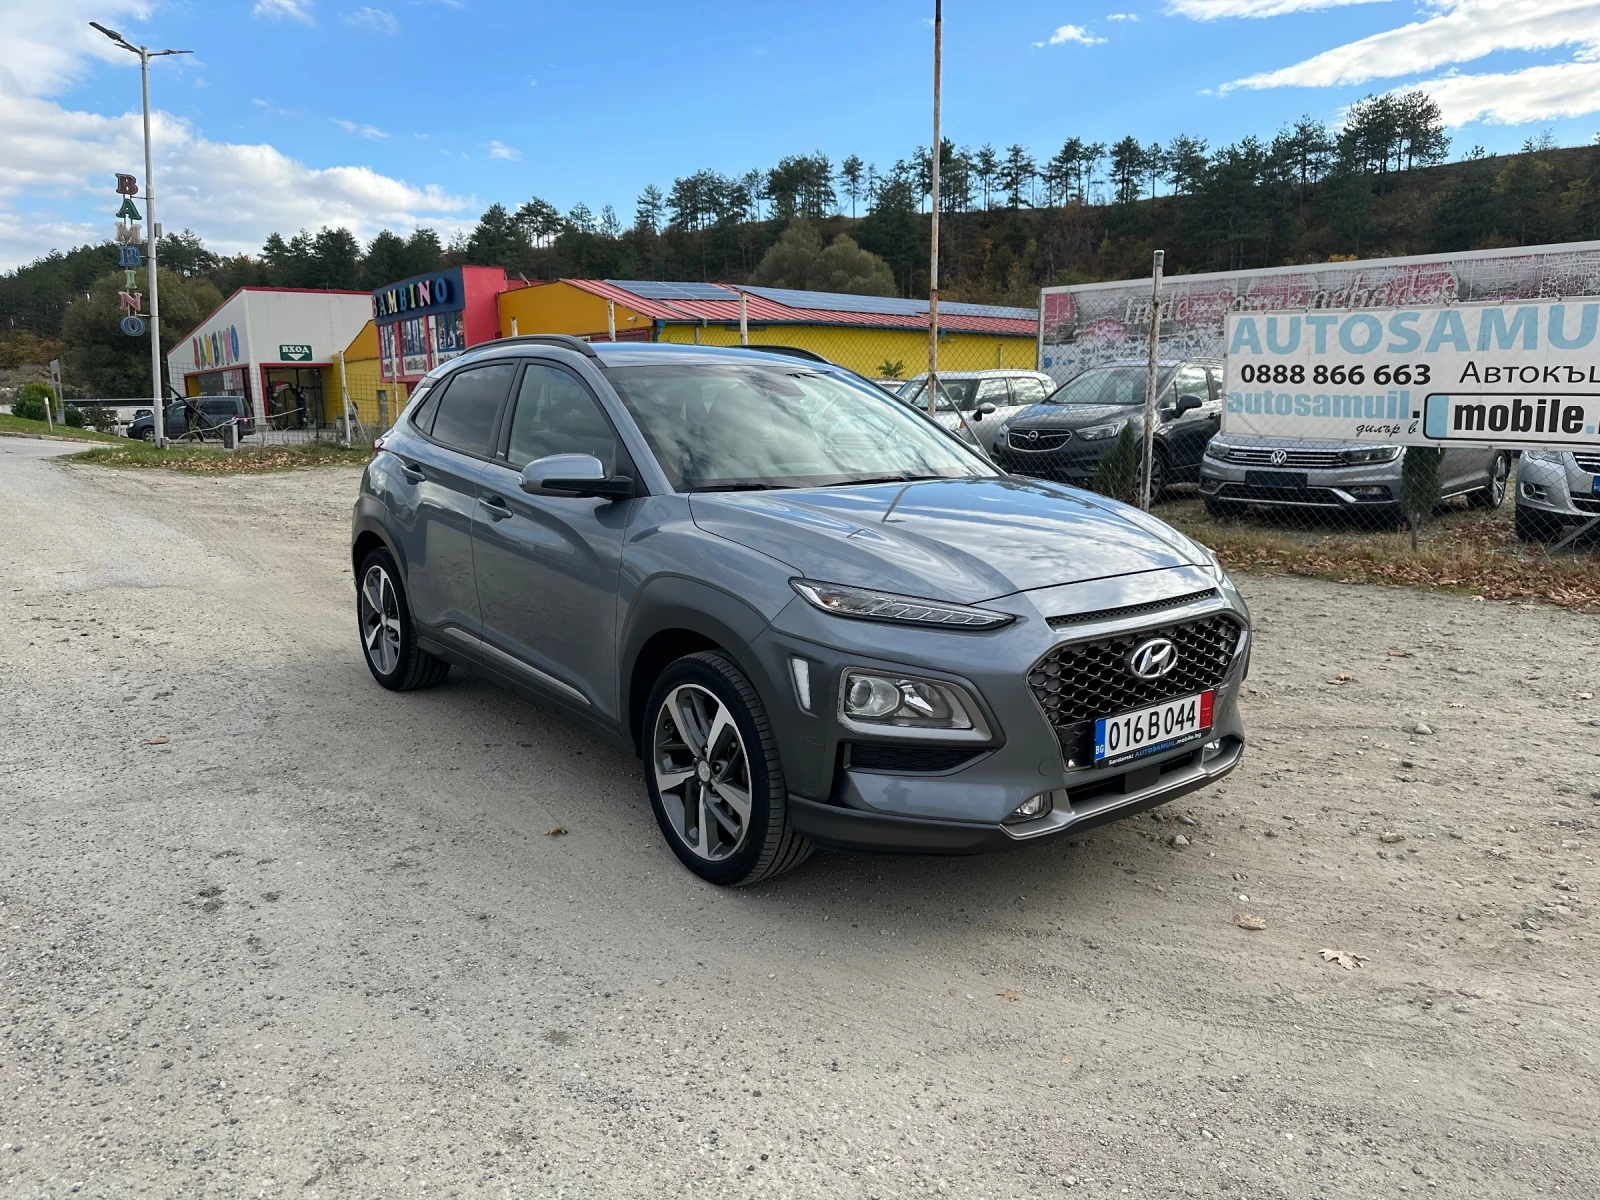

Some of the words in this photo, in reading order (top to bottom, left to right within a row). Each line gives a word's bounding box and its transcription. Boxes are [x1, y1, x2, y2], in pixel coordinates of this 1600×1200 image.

[114, 173, 145, 336] BAMBINO
[371, 278, 448, 318] BAMBINO
[193, 325, 239, 370] BAMBINO
[282, 345, 310, 353] ВХОД
[1229, 304, 1600, 354] AUTOSAMU
[1241, 364, 1305, 384] 0888
[1313, 364, 1365, 385] 866
[1373, 364, 1431, 385] 663
[1453, 399, 1600, 434] mobile.
[1109, 700, 1196, 751] 016B044
[1096, 744, 1105, 754] BG
